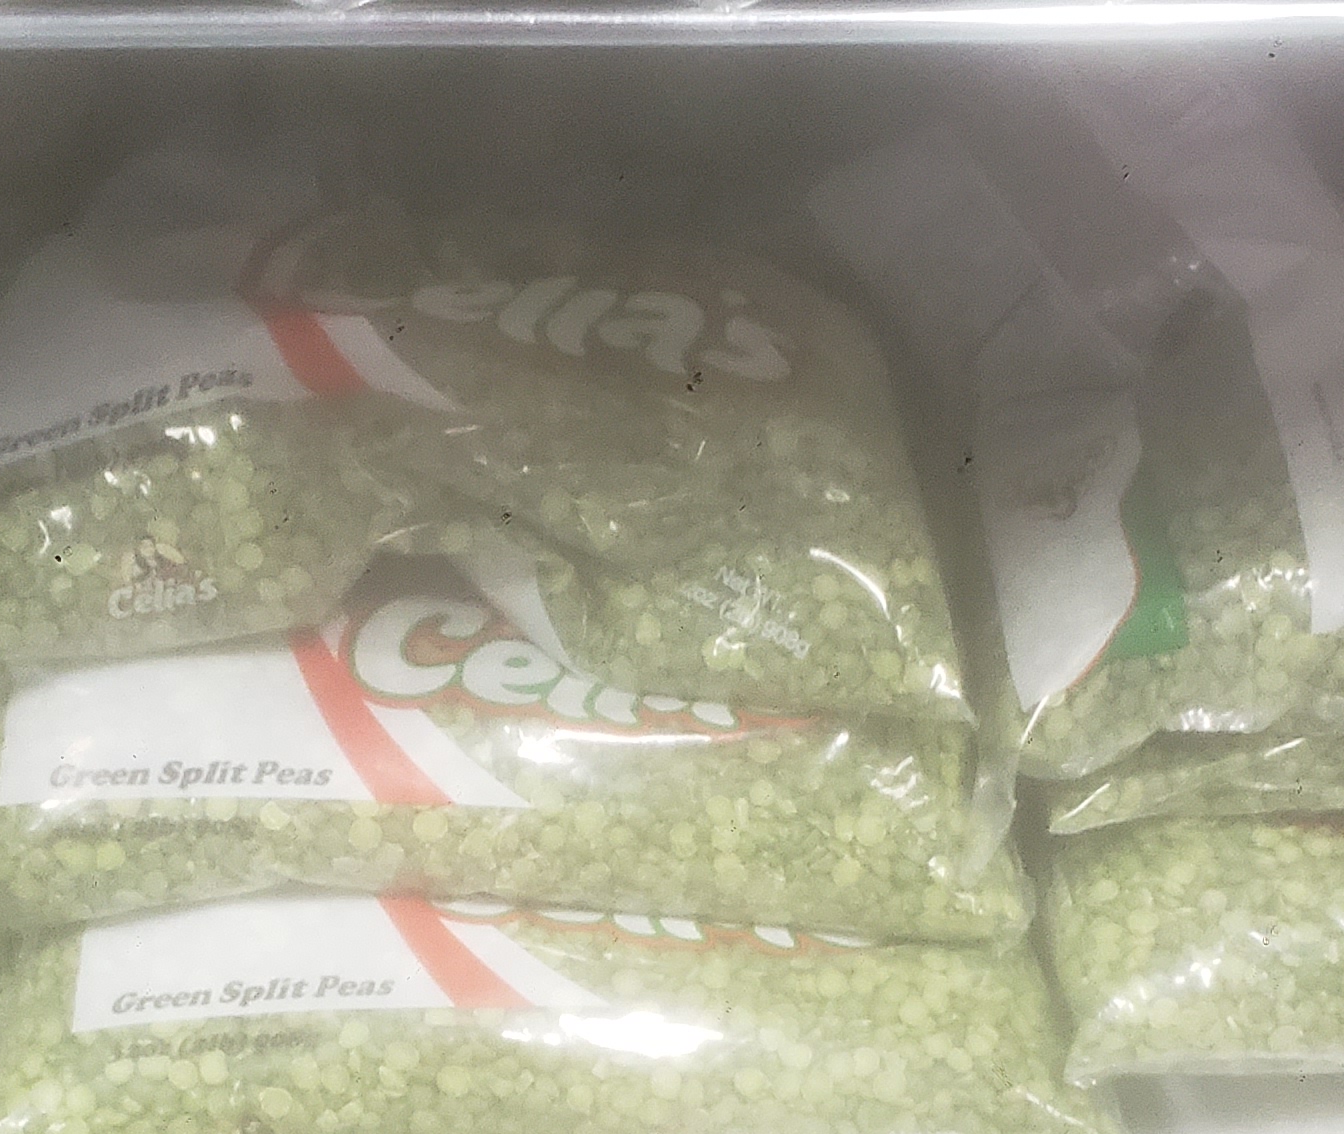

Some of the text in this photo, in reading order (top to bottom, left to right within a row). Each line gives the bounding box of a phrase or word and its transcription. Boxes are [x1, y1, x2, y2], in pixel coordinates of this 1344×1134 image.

[87, 384, 170, 427] Split
[177, 367, 254, 400] Peas
[48, 760, 334, 790] Green Split Peas
[111, 974, 396, 1014] Green Split Peas
